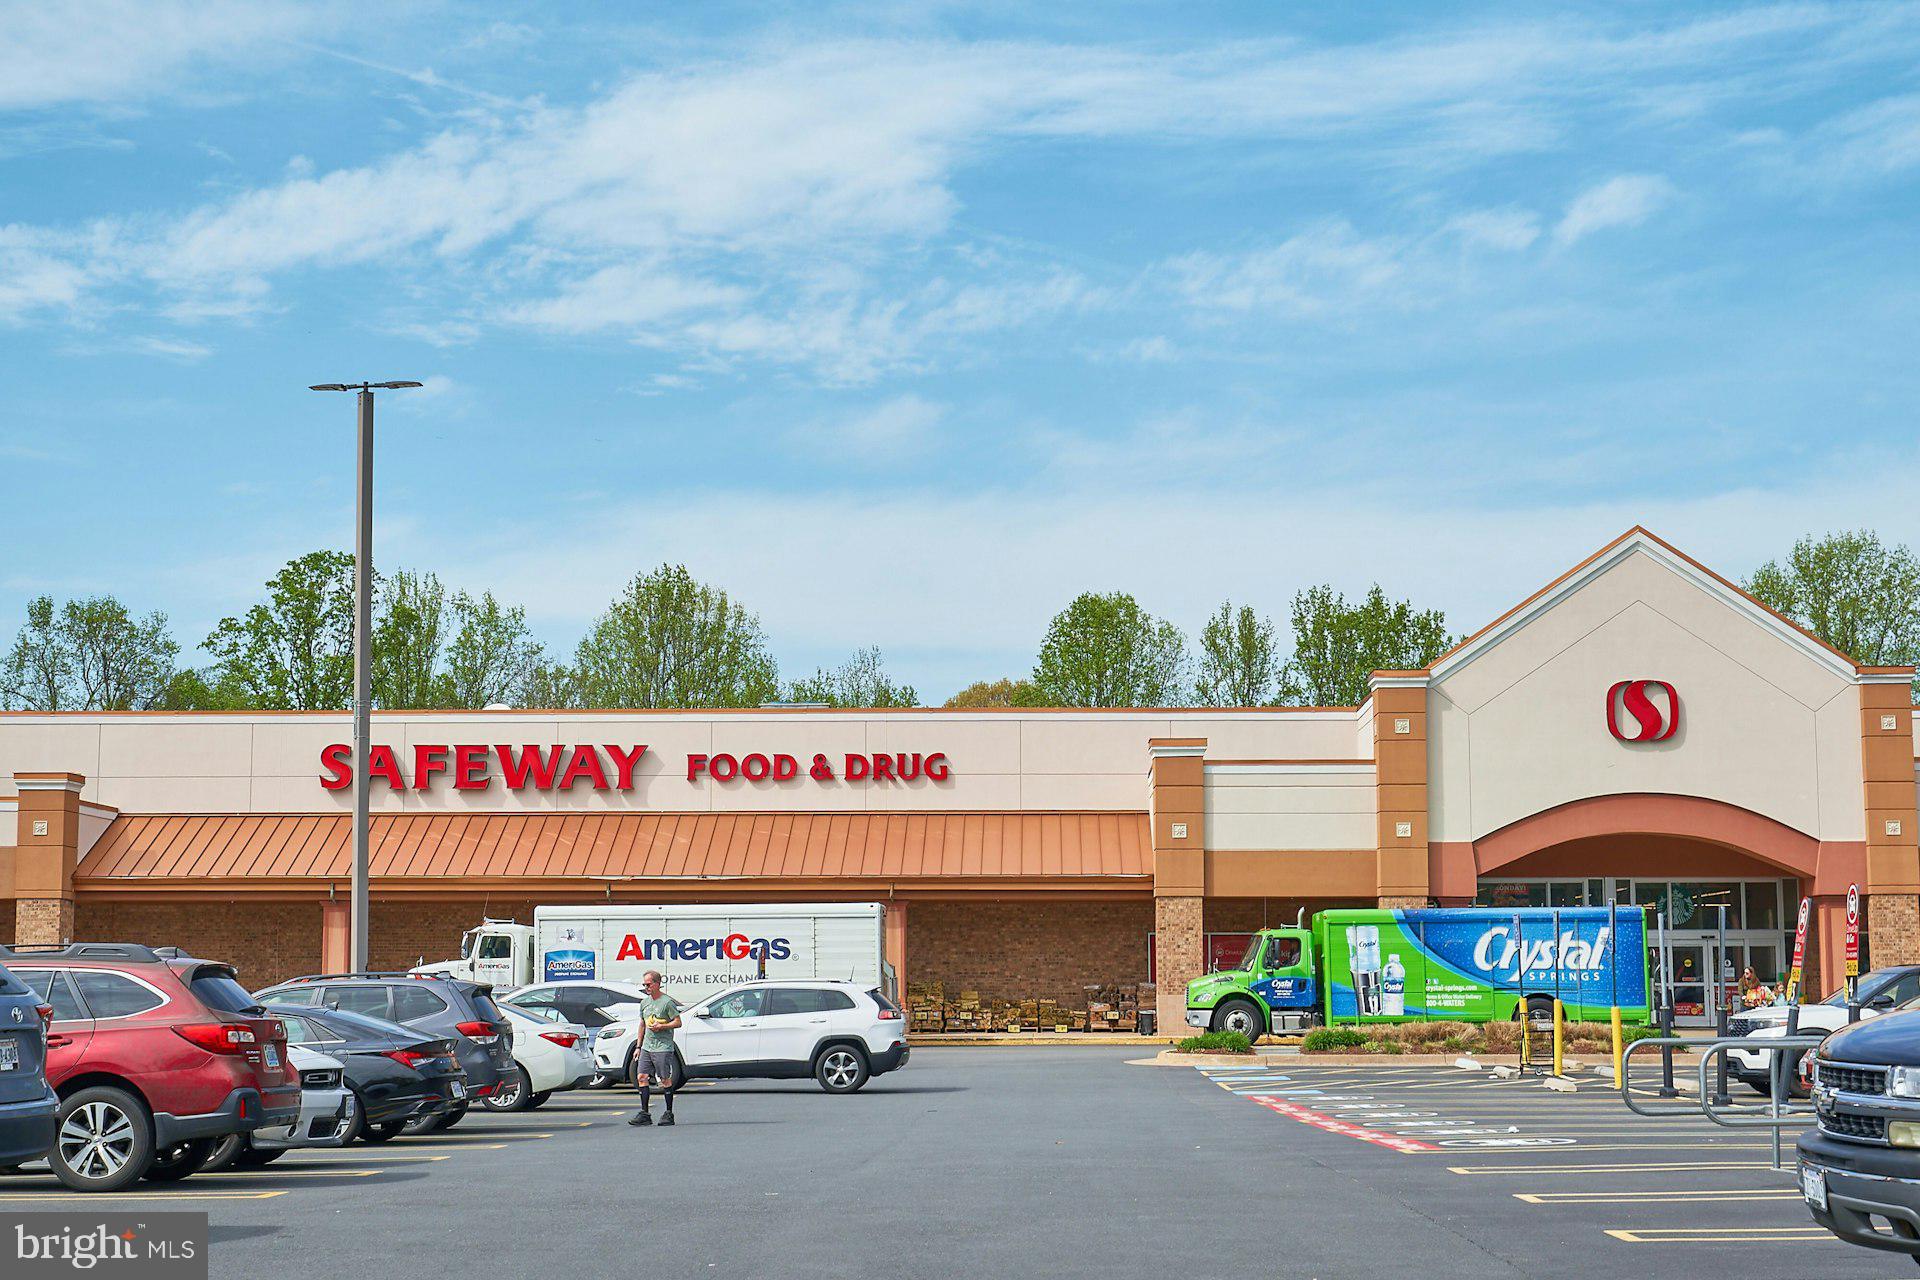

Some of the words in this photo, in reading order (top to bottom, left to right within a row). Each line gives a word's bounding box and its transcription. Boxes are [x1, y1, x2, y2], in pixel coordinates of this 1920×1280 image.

[319, 744, 649, 790] SAFEWAY
[686, 753, 798, 781] FOOD
[809, 753, 835, 780] &
[844, 752, 949, 781] DRUG
[615, 933, 791, 961] AmeriGas
[1473, 926, 1611, 982] Crystal
[548, 960, 594, 972] AmeriGas
[661, 974, 700, 984] OPANE
[705, 974, 769, 984] EXCHAN
[1271, 979, 1294, 989] Crystal
[1529, 972, 1600, 981] SPRINGS
